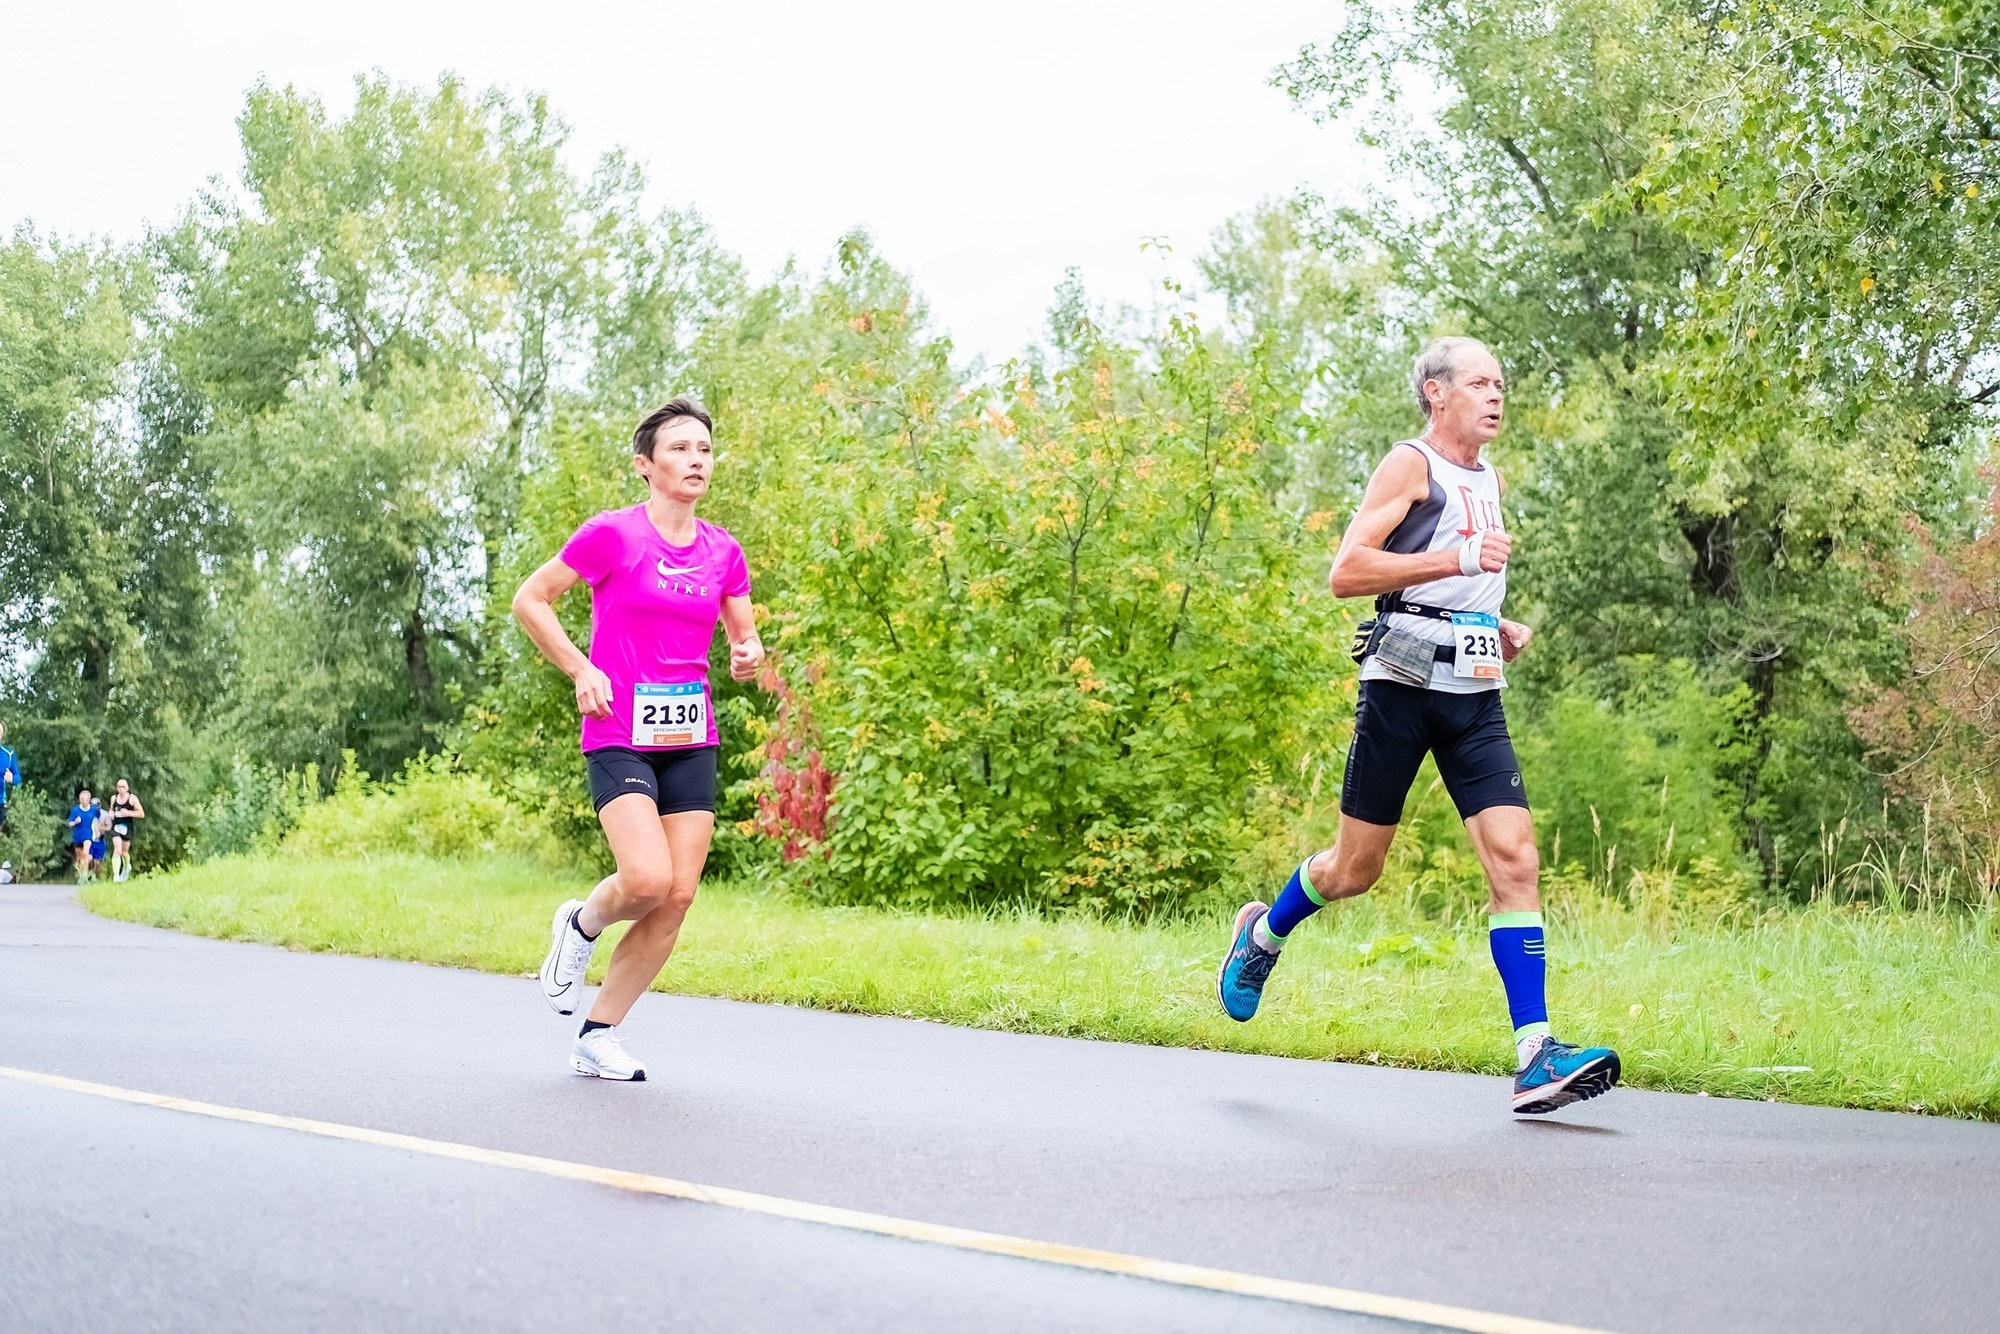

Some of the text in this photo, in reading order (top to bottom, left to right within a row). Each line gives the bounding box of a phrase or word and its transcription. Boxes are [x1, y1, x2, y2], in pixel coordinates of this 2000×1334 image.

[656, 578, 708, 597] NIKE
[1463, 634, 1500, 660] 233
[642, 703, 699, 725] 2130
